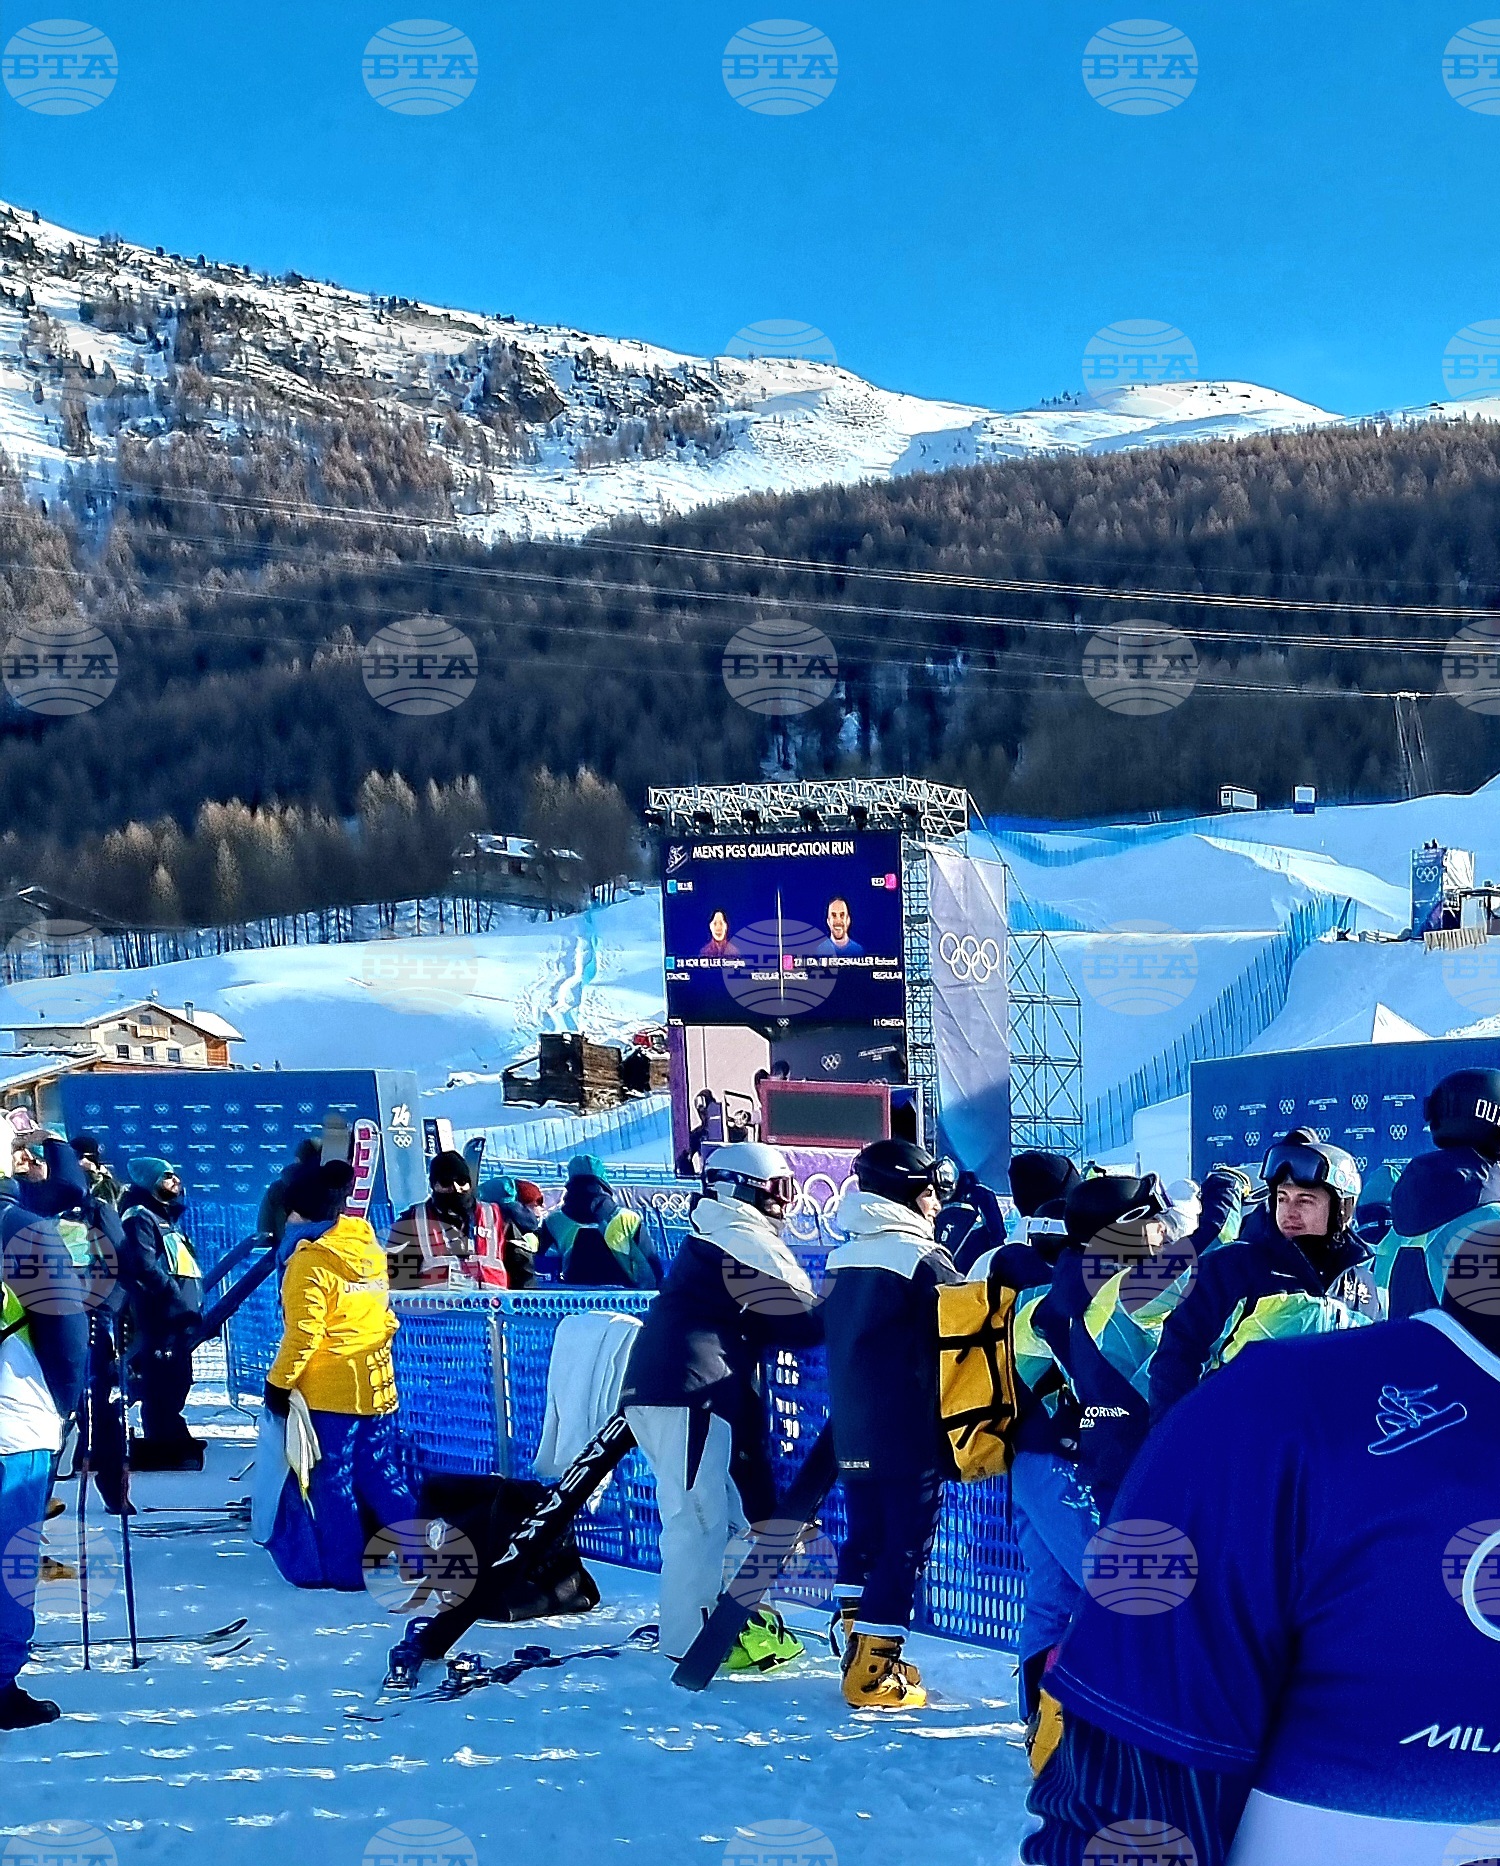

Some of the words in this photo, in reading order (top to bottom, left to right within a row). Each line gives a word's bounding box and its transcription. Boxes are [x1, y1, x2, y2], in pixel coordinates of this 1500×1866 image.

[693, 845, 724, 859] MEN'S
[726, 844, 746, 858] PGS
[748, 842, 830, 857] QUALIFICATION
[832, 841, 855, 855] RUN
